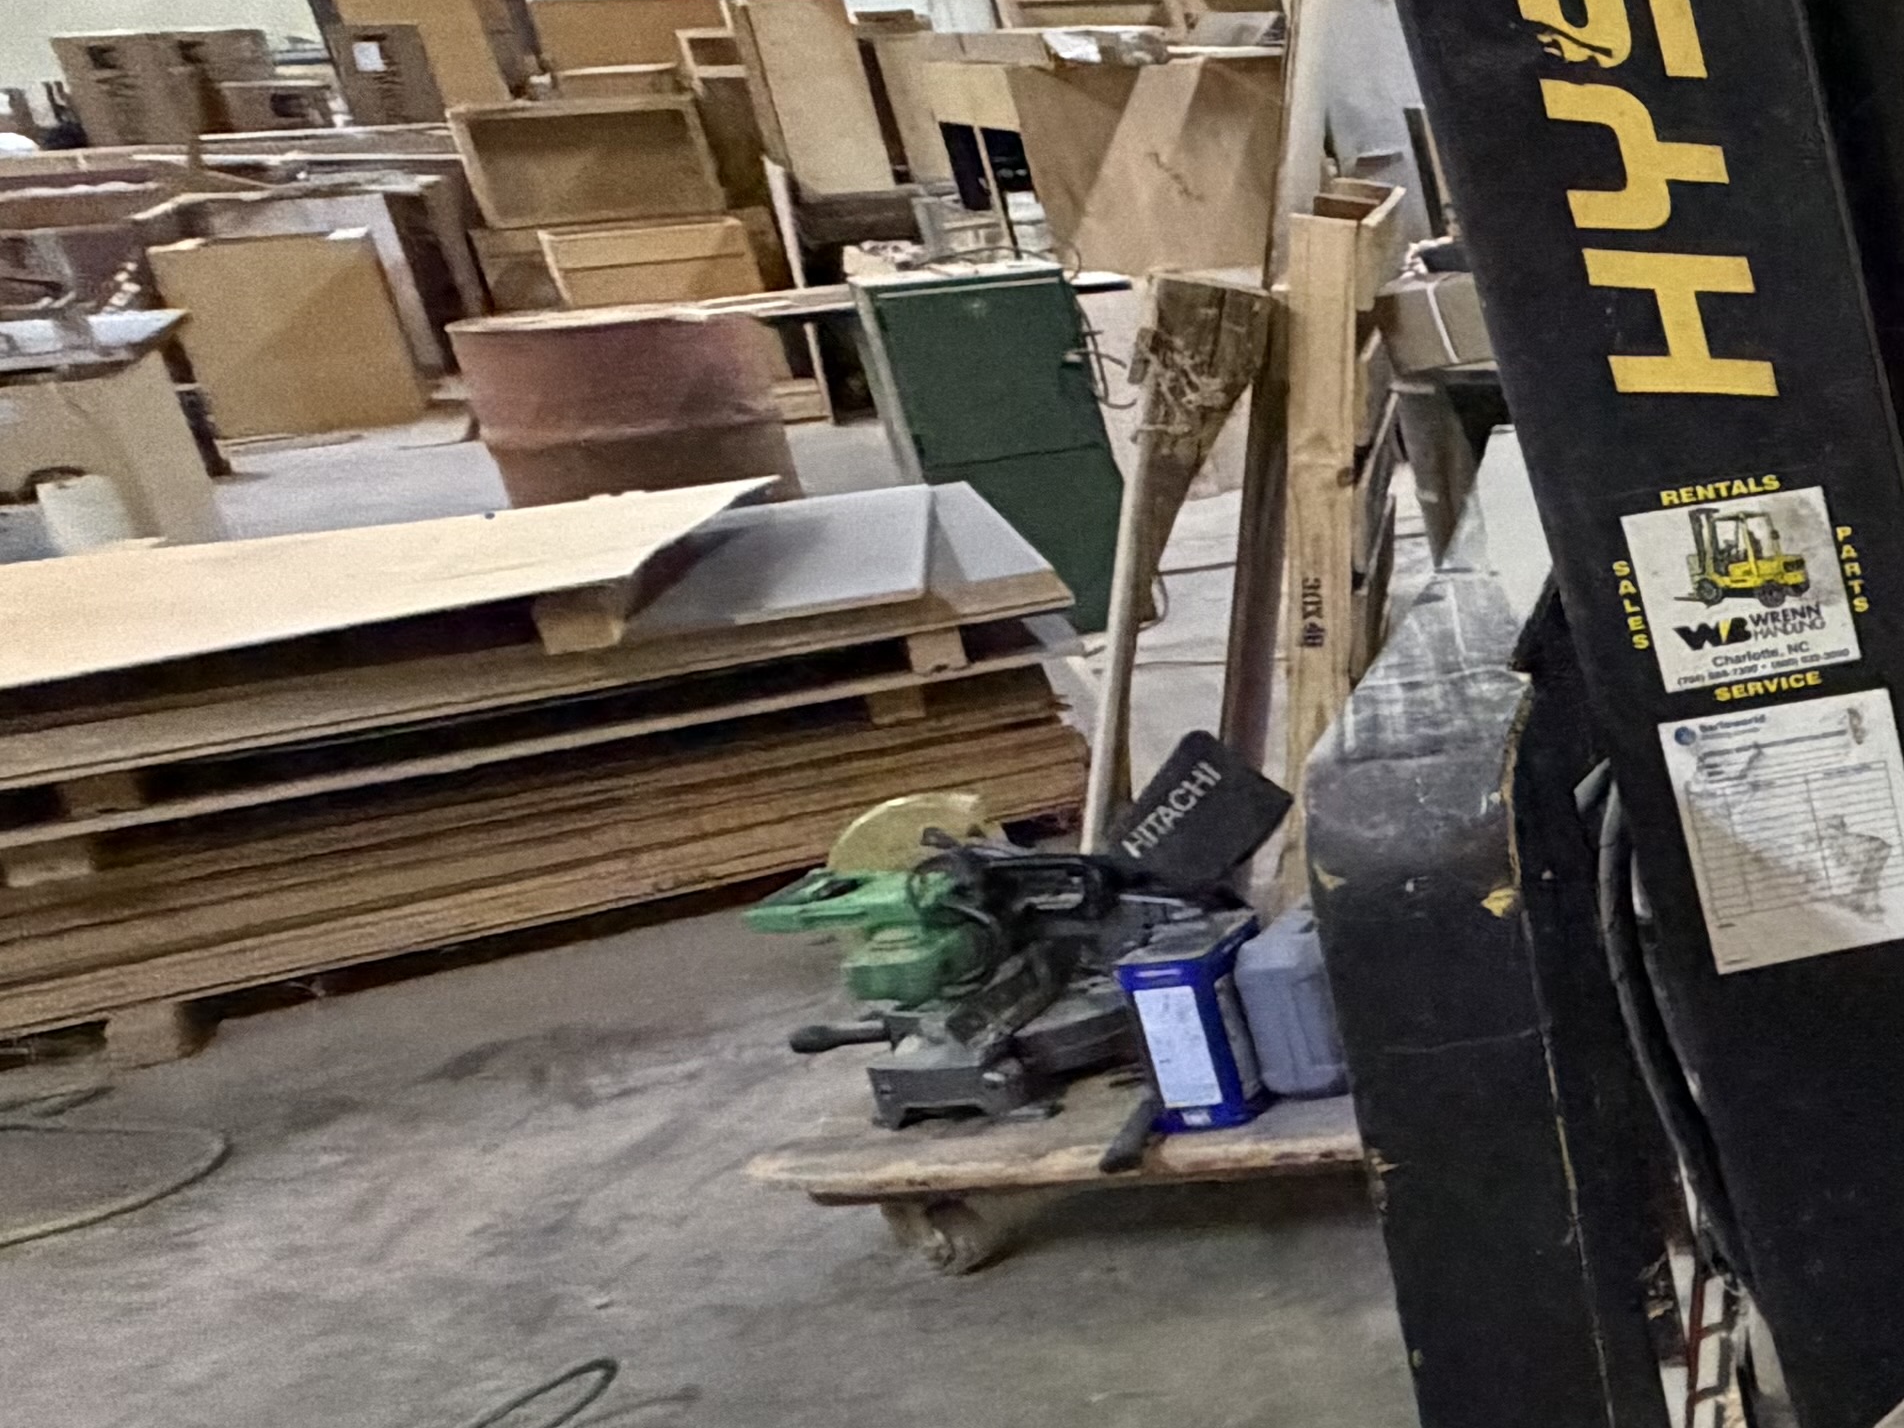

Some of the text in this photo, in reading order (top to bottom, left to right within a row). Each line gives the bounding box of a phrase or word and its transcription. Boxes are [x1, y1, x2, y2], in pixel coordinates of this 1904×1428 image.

[1660, 474, 1781, 506] RENTALS
[1835, 526, 1870, 613] PARTS
[1612, 560, 1651, 650] SALES
[1749, 603, 1822, 627] WRENN
[1787, 640, 1811, 655] NC
[1712, 670, 1824, 702] SERVICE
[1120, 760, 1223, 860] HITACHI
